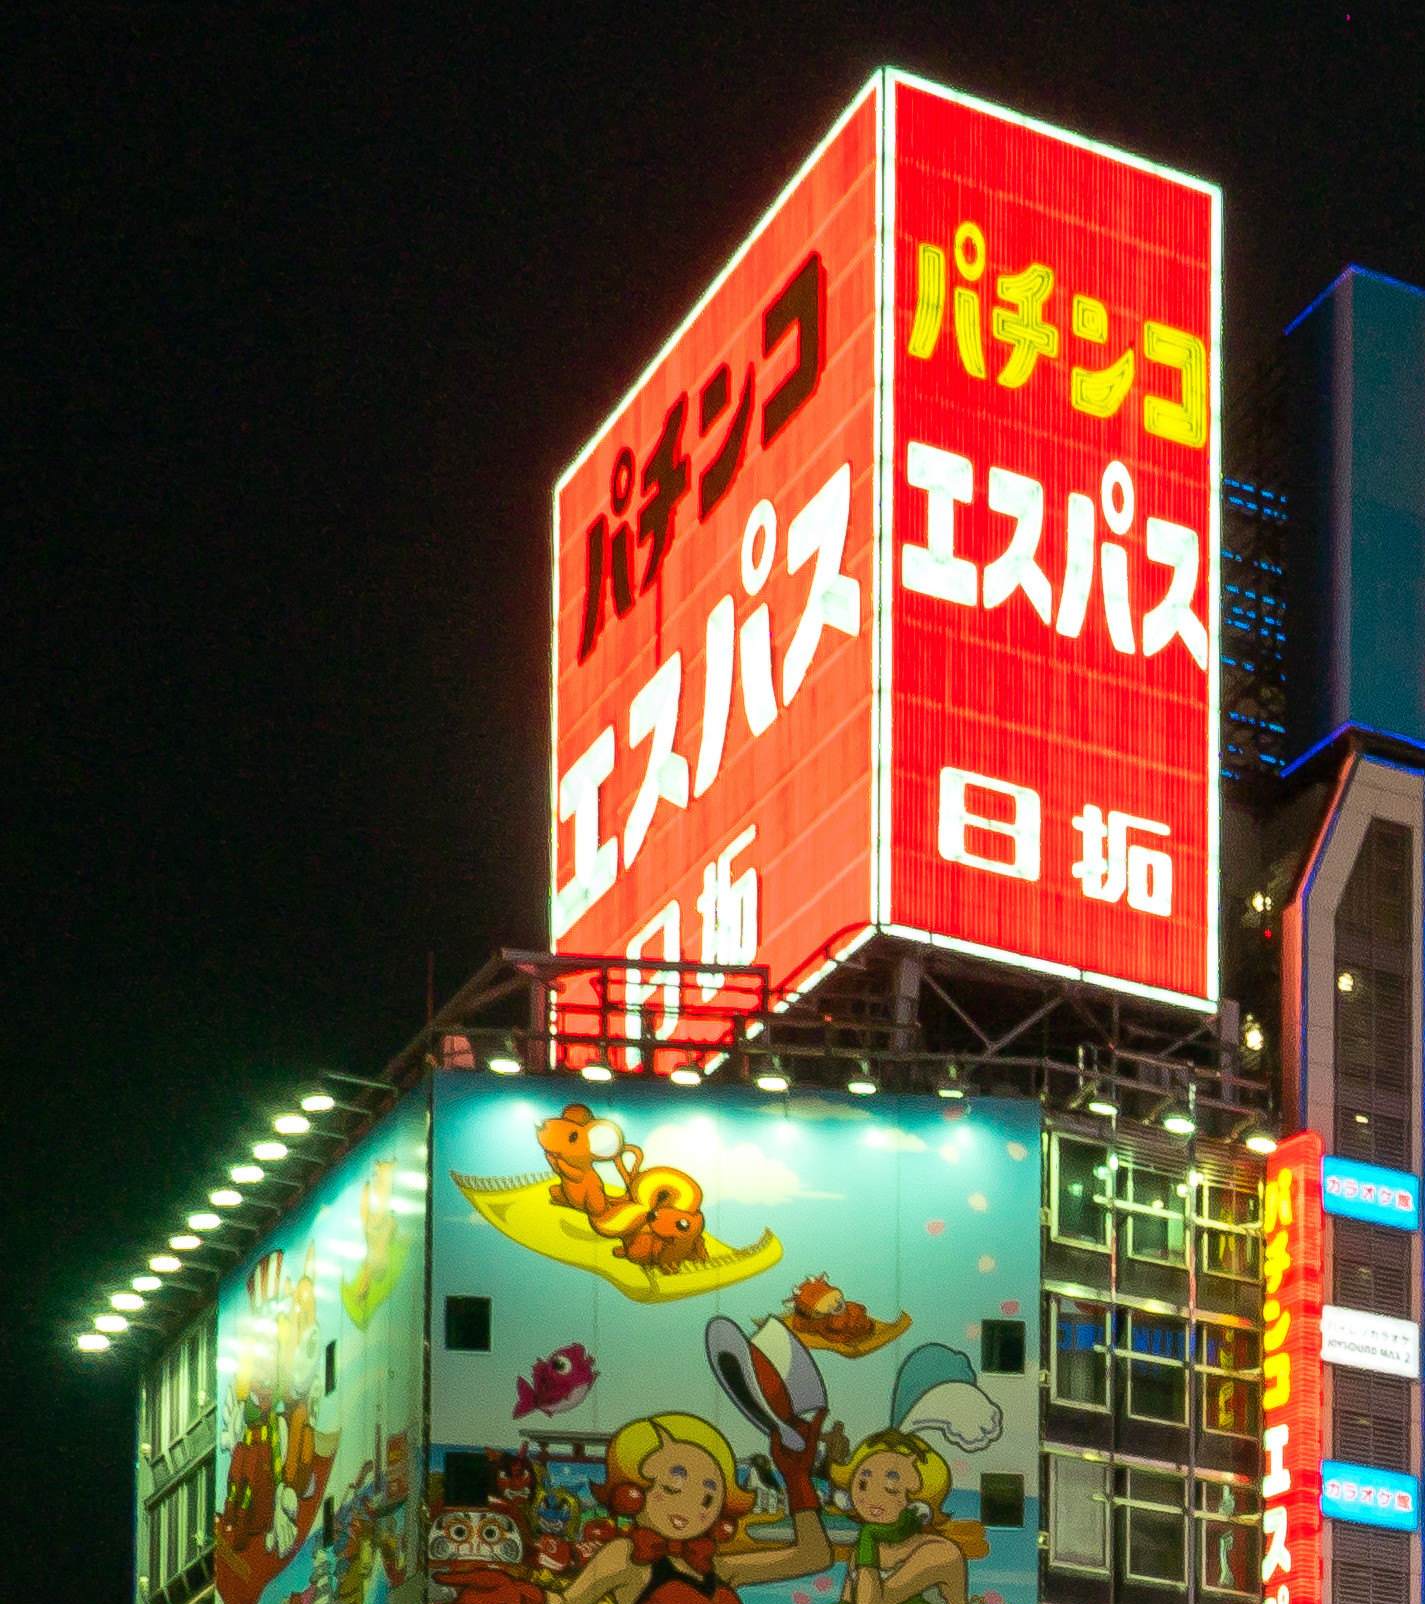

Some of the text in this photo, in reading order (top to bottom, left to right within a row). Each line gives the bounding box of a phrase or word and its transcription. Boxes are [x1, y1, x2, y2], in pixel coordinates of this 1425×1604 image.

[908, 222, 1207, 447] パチンコ
[578, 250, 826, 664] パチンコ
[901, 440, 1209, 671] エスパス
[552, 461, 861, 938] エスパス
[937, 766, 1174, 918] 日拓
[1263, 1168, 1293, 1410] パチンコ
